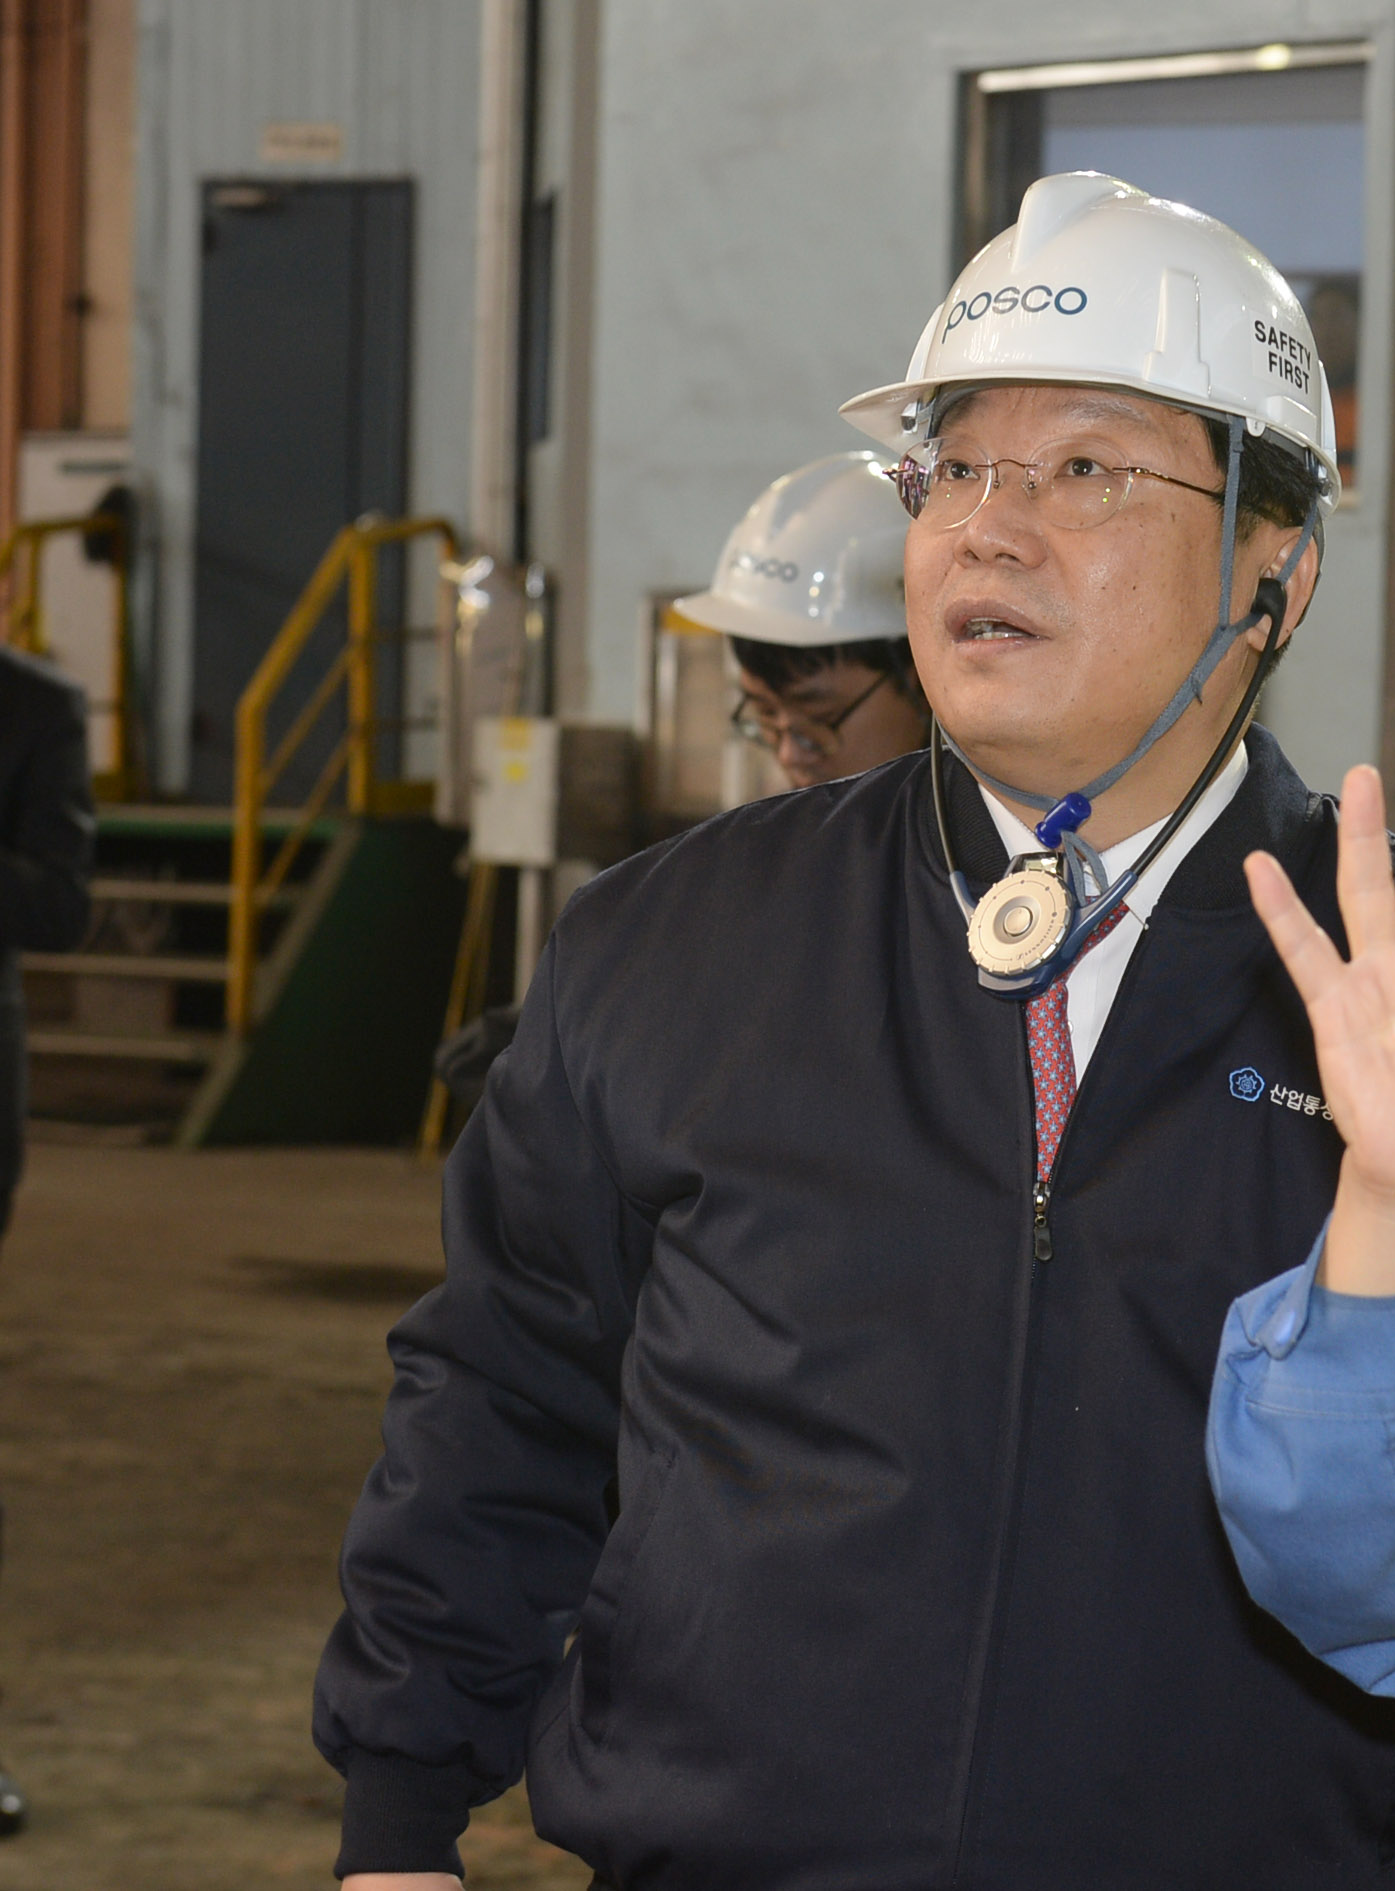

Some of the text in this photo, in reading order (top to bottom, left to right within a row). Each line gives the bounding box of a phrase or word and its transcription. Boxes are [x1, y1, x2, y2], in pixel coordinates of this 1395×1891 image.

[941, 285, 1088, 344] posco
[1254, 320, 1311, 371] SAFETY
[1268, 351, 1310, 394] FIRST
